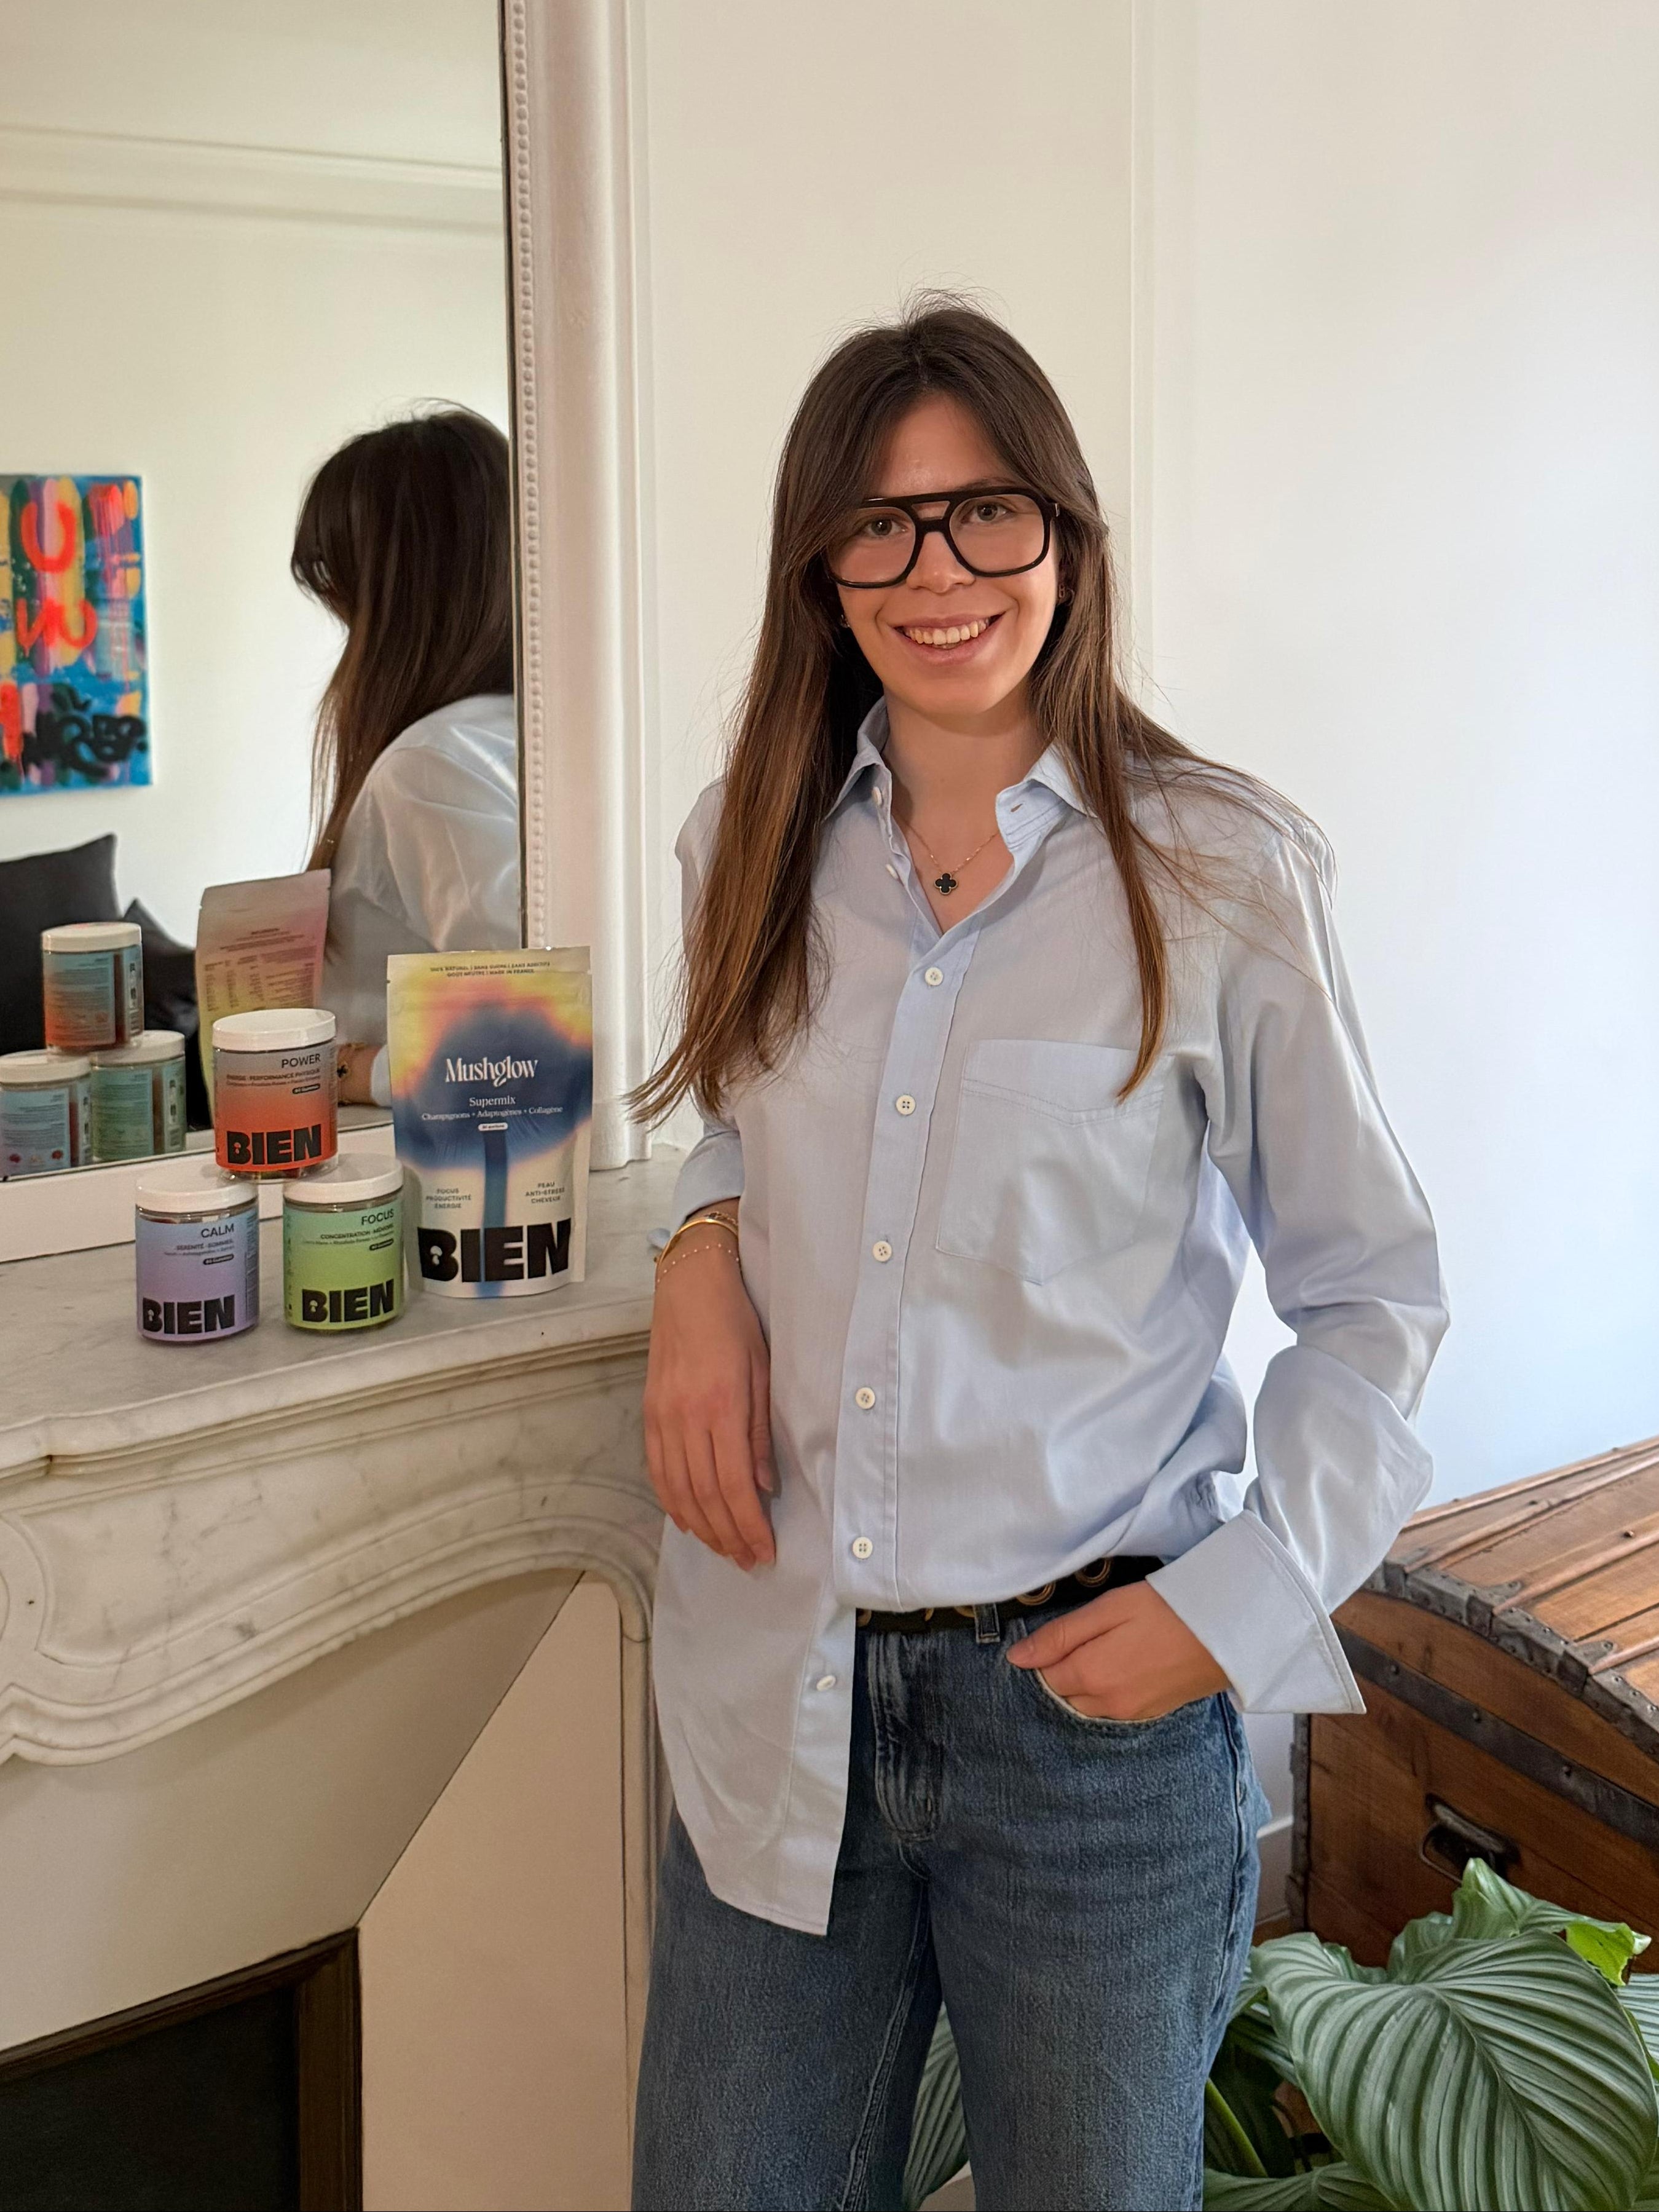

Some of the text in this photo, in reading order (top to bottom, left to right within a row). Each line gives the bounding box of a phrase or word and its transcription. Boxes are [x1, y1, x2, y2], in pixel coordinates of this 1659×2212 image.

[282, 1053, 321, 1068] POWER
[445, 1056, 538, 1087] Mushglow
[469, 1095, 516, 1107] Supermix
[226, 1124, 321, 1165] BIEN
[200, 1223, 234, 1238] CALM
[361, 1209, 394, 1225] FOCUS
[417, 1218, 571, 1282] BIEN
[142, 1294, 235, 1334] BIEN
[302, 1278, 394, 1322] BIEN
